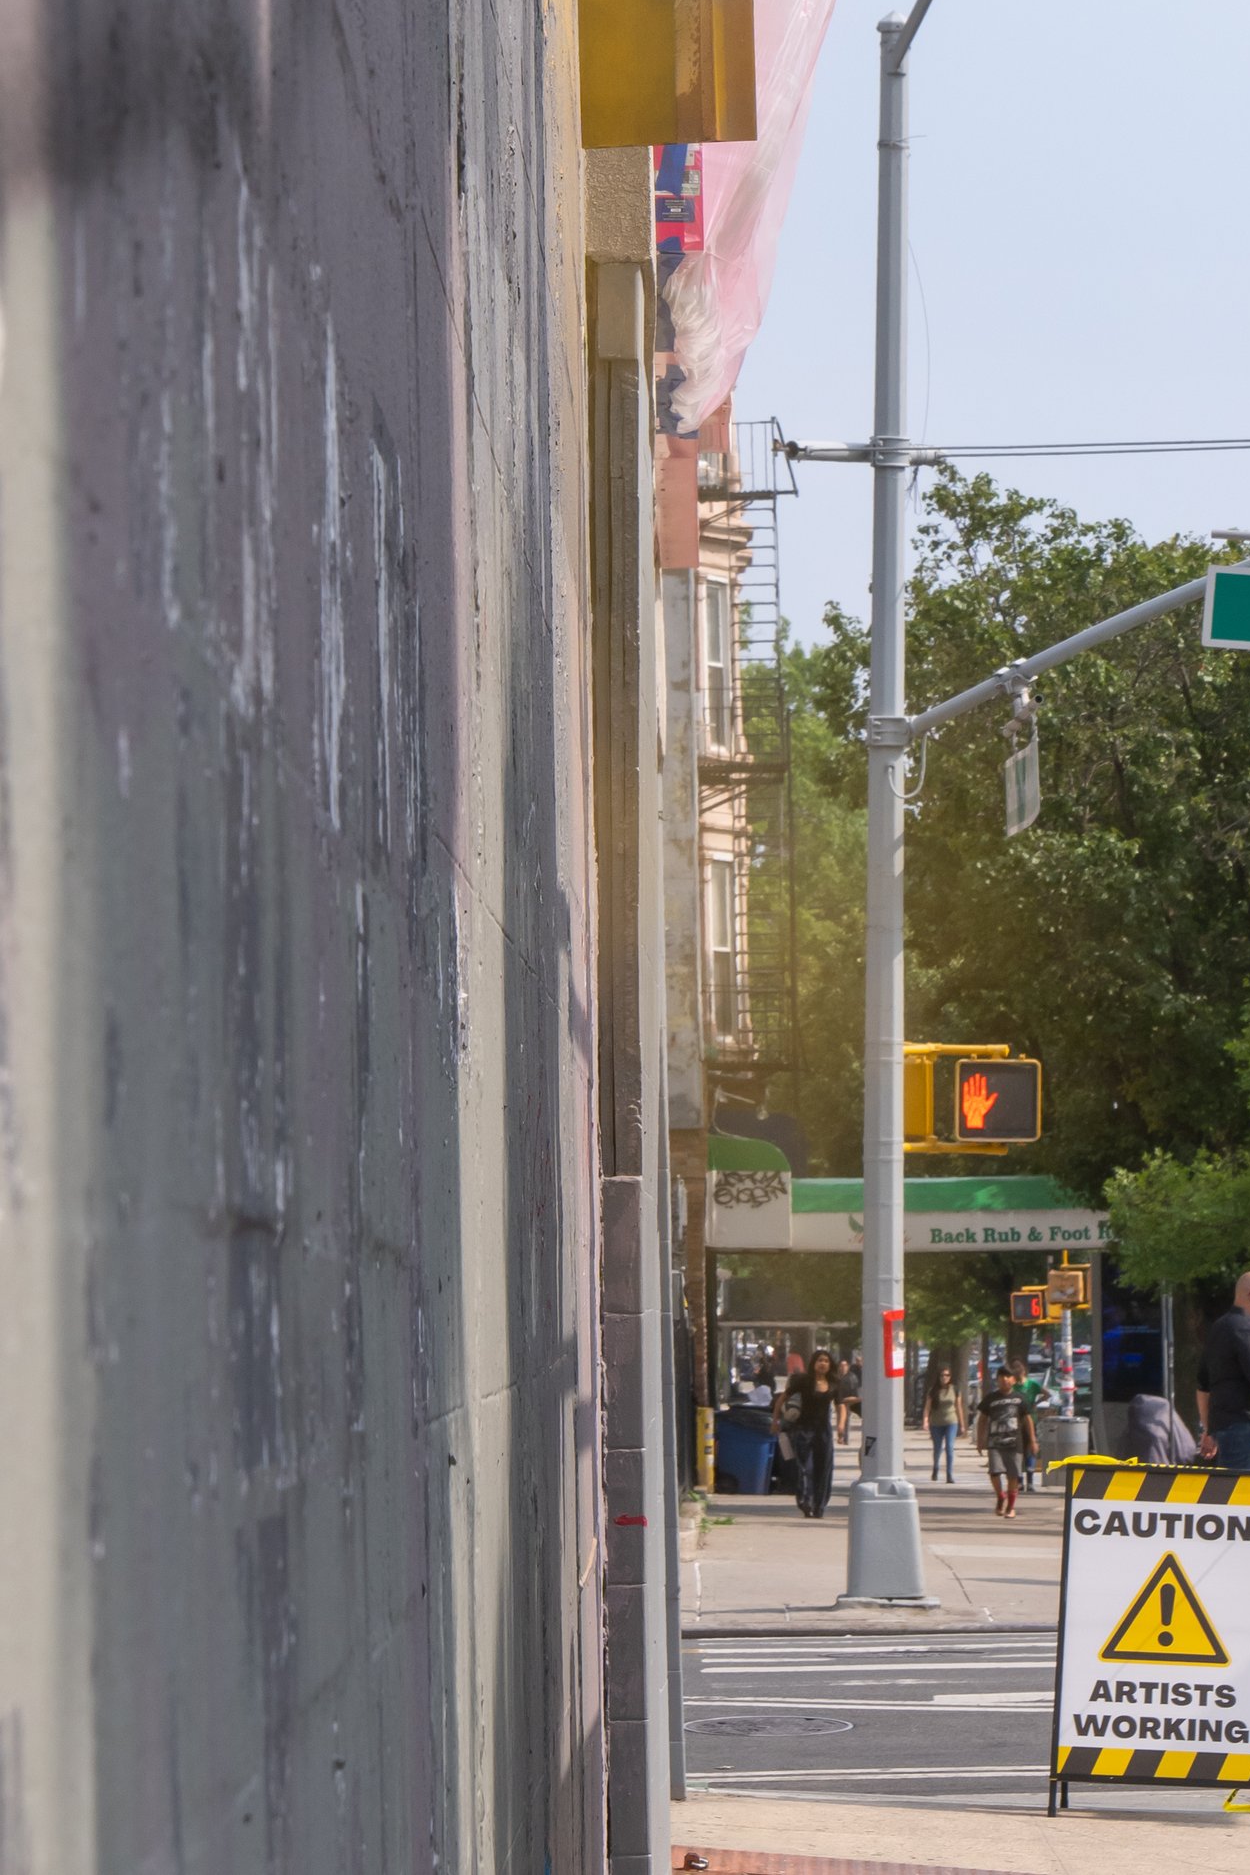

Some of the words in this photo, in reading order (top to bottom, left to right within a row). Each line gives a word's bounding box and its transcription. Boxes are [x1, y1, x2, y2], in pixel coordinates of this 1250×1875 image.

[930, 1228, 978, 1244] Back
[982, 1227, 1021, 1243] Rub
[1027, 1226, 1044, 1242] &
[1048, 1225, 1092, 1241] Foot
[1031, 1298, 1041, 1317] 6
[1089, 1679, 1237, 1709] ARTISTS
[1073, 1713, 1250, 1744] WORKING
